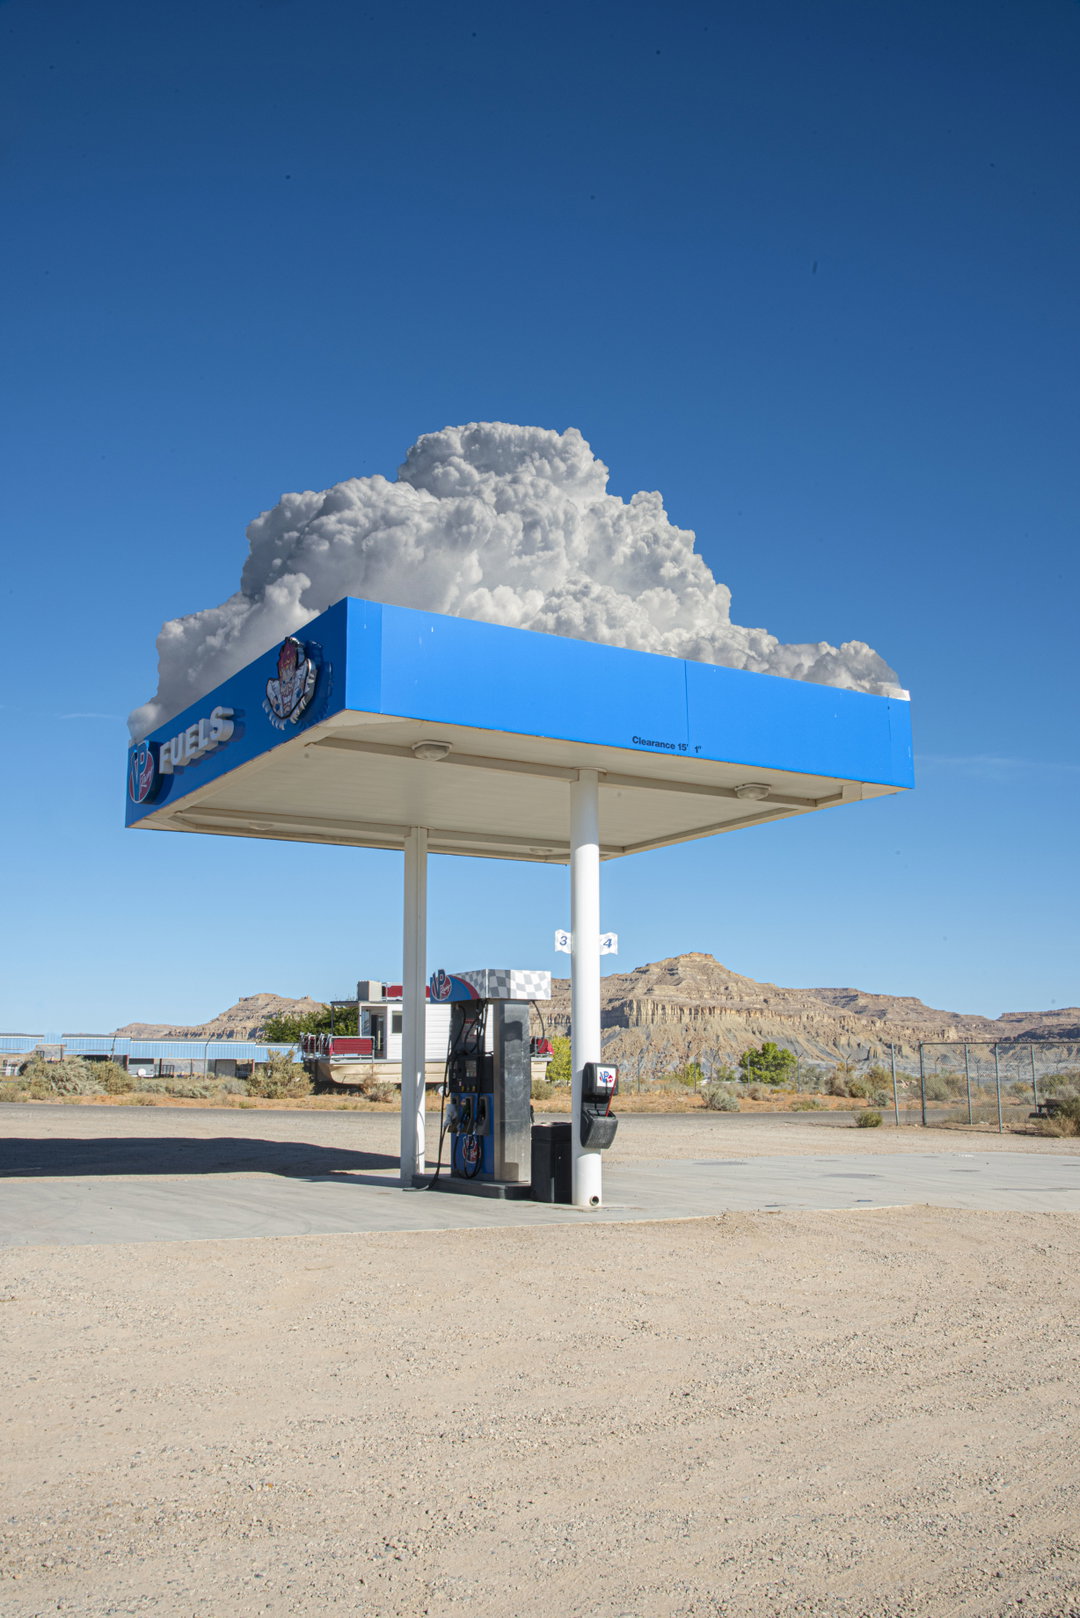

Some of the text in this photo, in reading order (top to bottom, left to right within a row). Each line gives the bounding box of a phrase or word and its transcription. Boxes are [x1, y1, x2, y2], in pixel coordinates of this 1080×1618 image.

[632, 736, 676, 750] Clearance
[131, 740, 150, 802] VP
[159, 706, 234, 774] FUELS
[560, 936, 568, 946] 3
[603, 938, 613, 948] 4
[433, 969, 446, 999] VP
